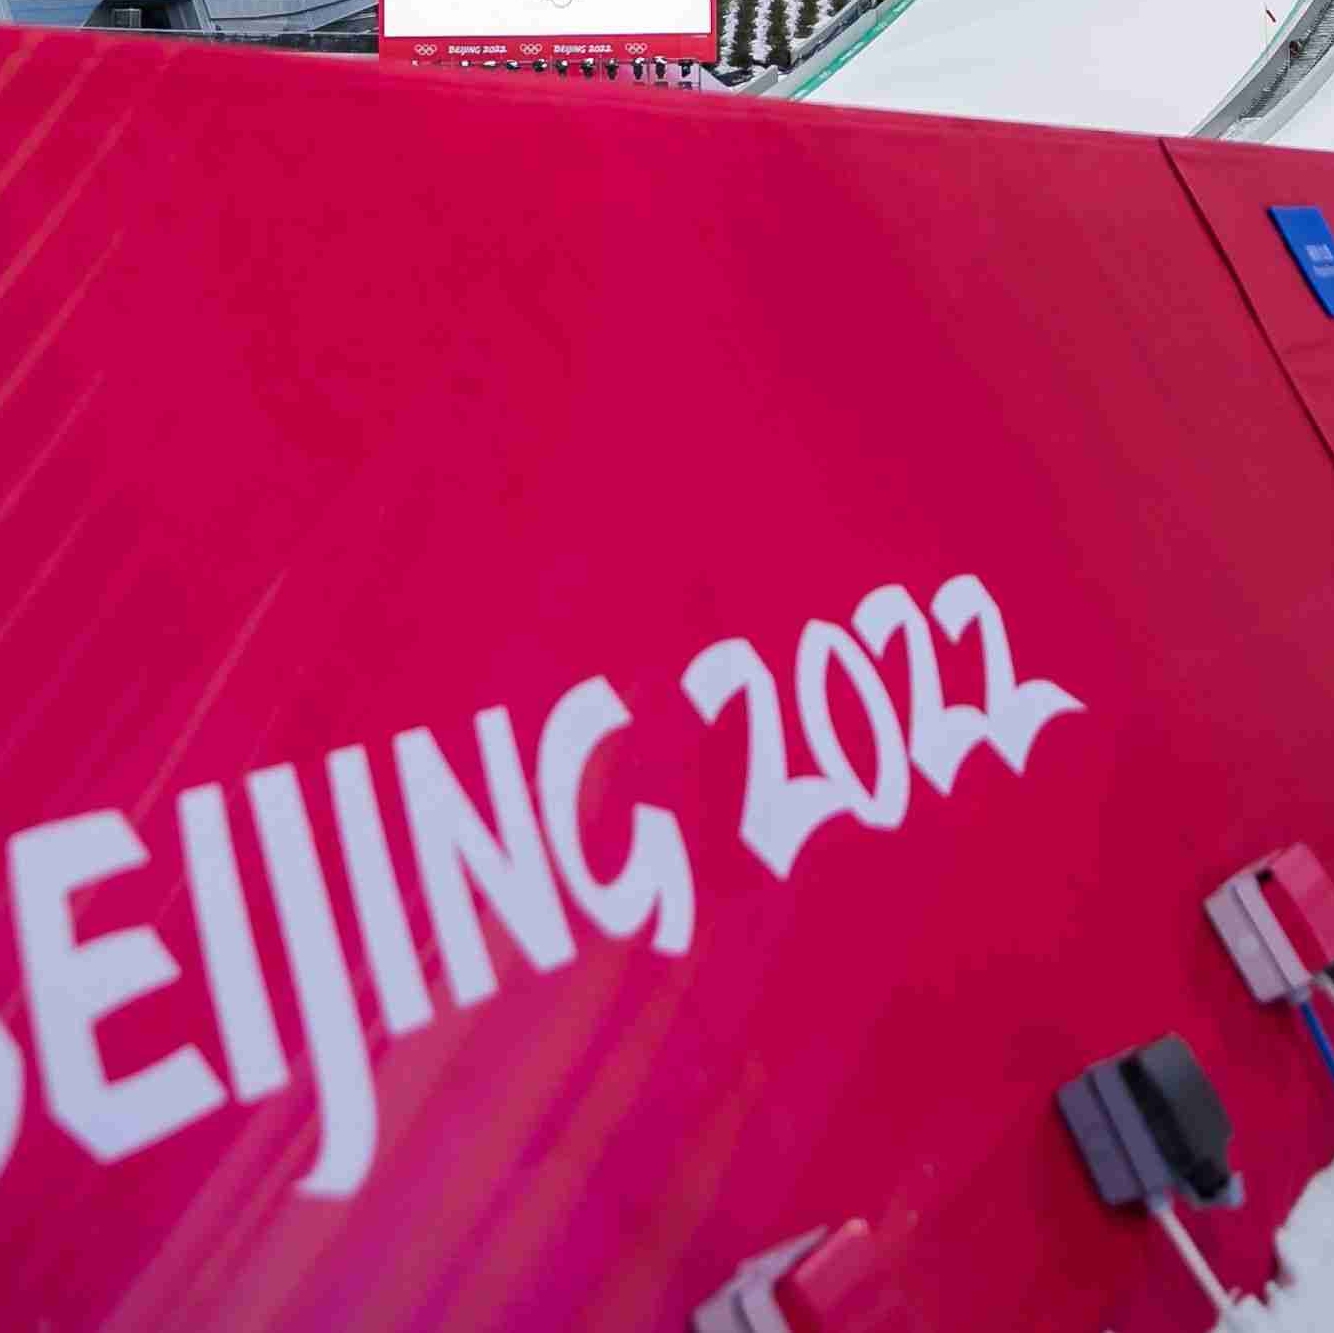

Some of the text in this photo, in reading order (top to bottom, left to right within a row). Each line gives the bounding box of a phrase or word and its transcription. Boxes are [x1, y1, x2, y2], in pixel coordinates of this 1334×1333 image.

[448, 44, 508, 55] BEIJING 2022
[554, 43, 613, 55] BEIJING 2022
[678, 572, 1089, 882] 2022
